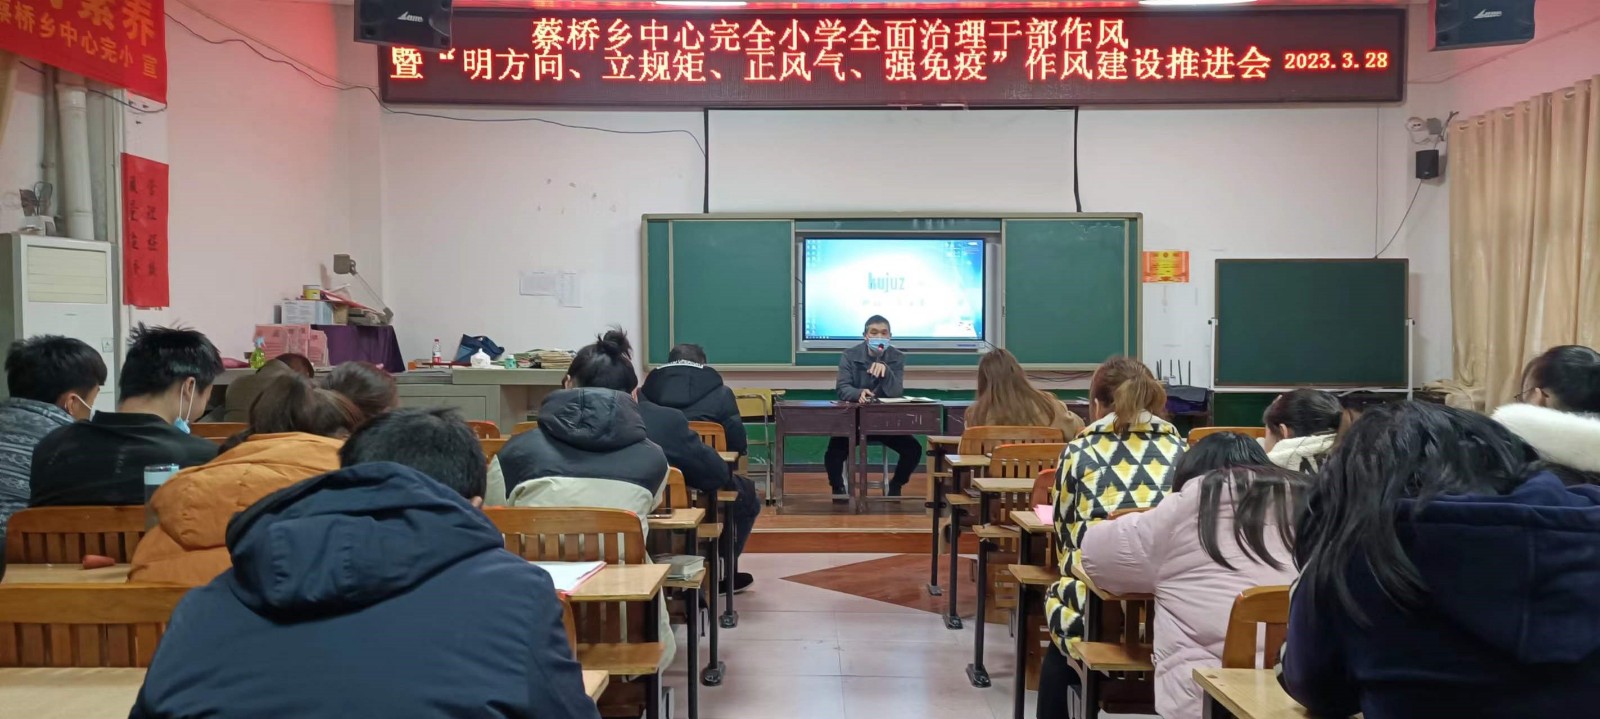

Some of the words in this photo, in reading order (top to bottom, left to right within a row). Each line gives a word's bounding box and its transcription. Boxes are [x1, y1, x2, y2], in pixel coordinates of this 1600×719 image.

[51, 0, 156, 47] 素养
[532, 17, 1129, 51] 蔡桥乡中心完全小学全面治理干部作风
[1284, 52, 1389, 69] 2023.3.28
